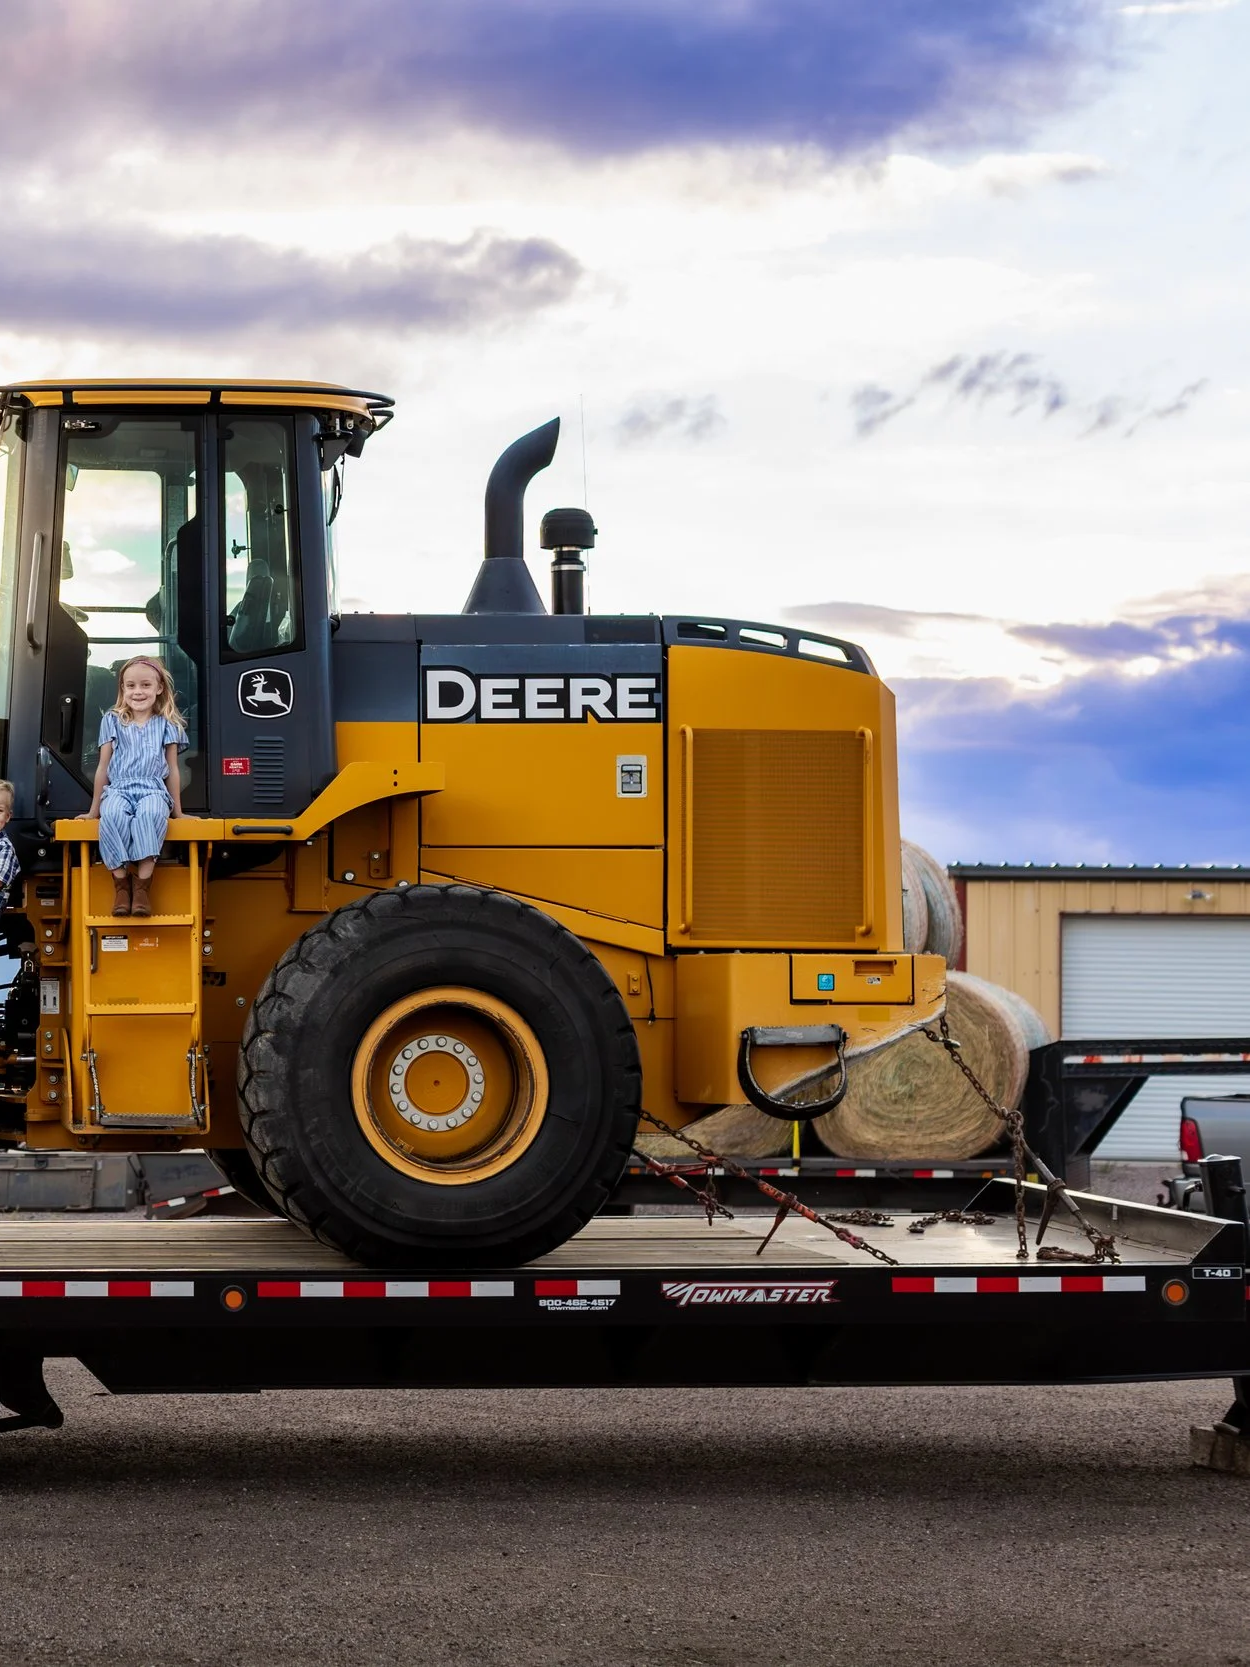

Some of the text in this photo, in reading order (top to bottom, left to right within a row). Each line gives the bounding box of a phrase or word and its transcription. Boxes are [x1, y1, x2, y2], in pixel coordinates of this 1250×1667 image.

[425, 669, 657, 719] DEERE
[1203, 1269, 1231, 1277] T-40
[662, 1281, 839, 1306] TOWMASTER
